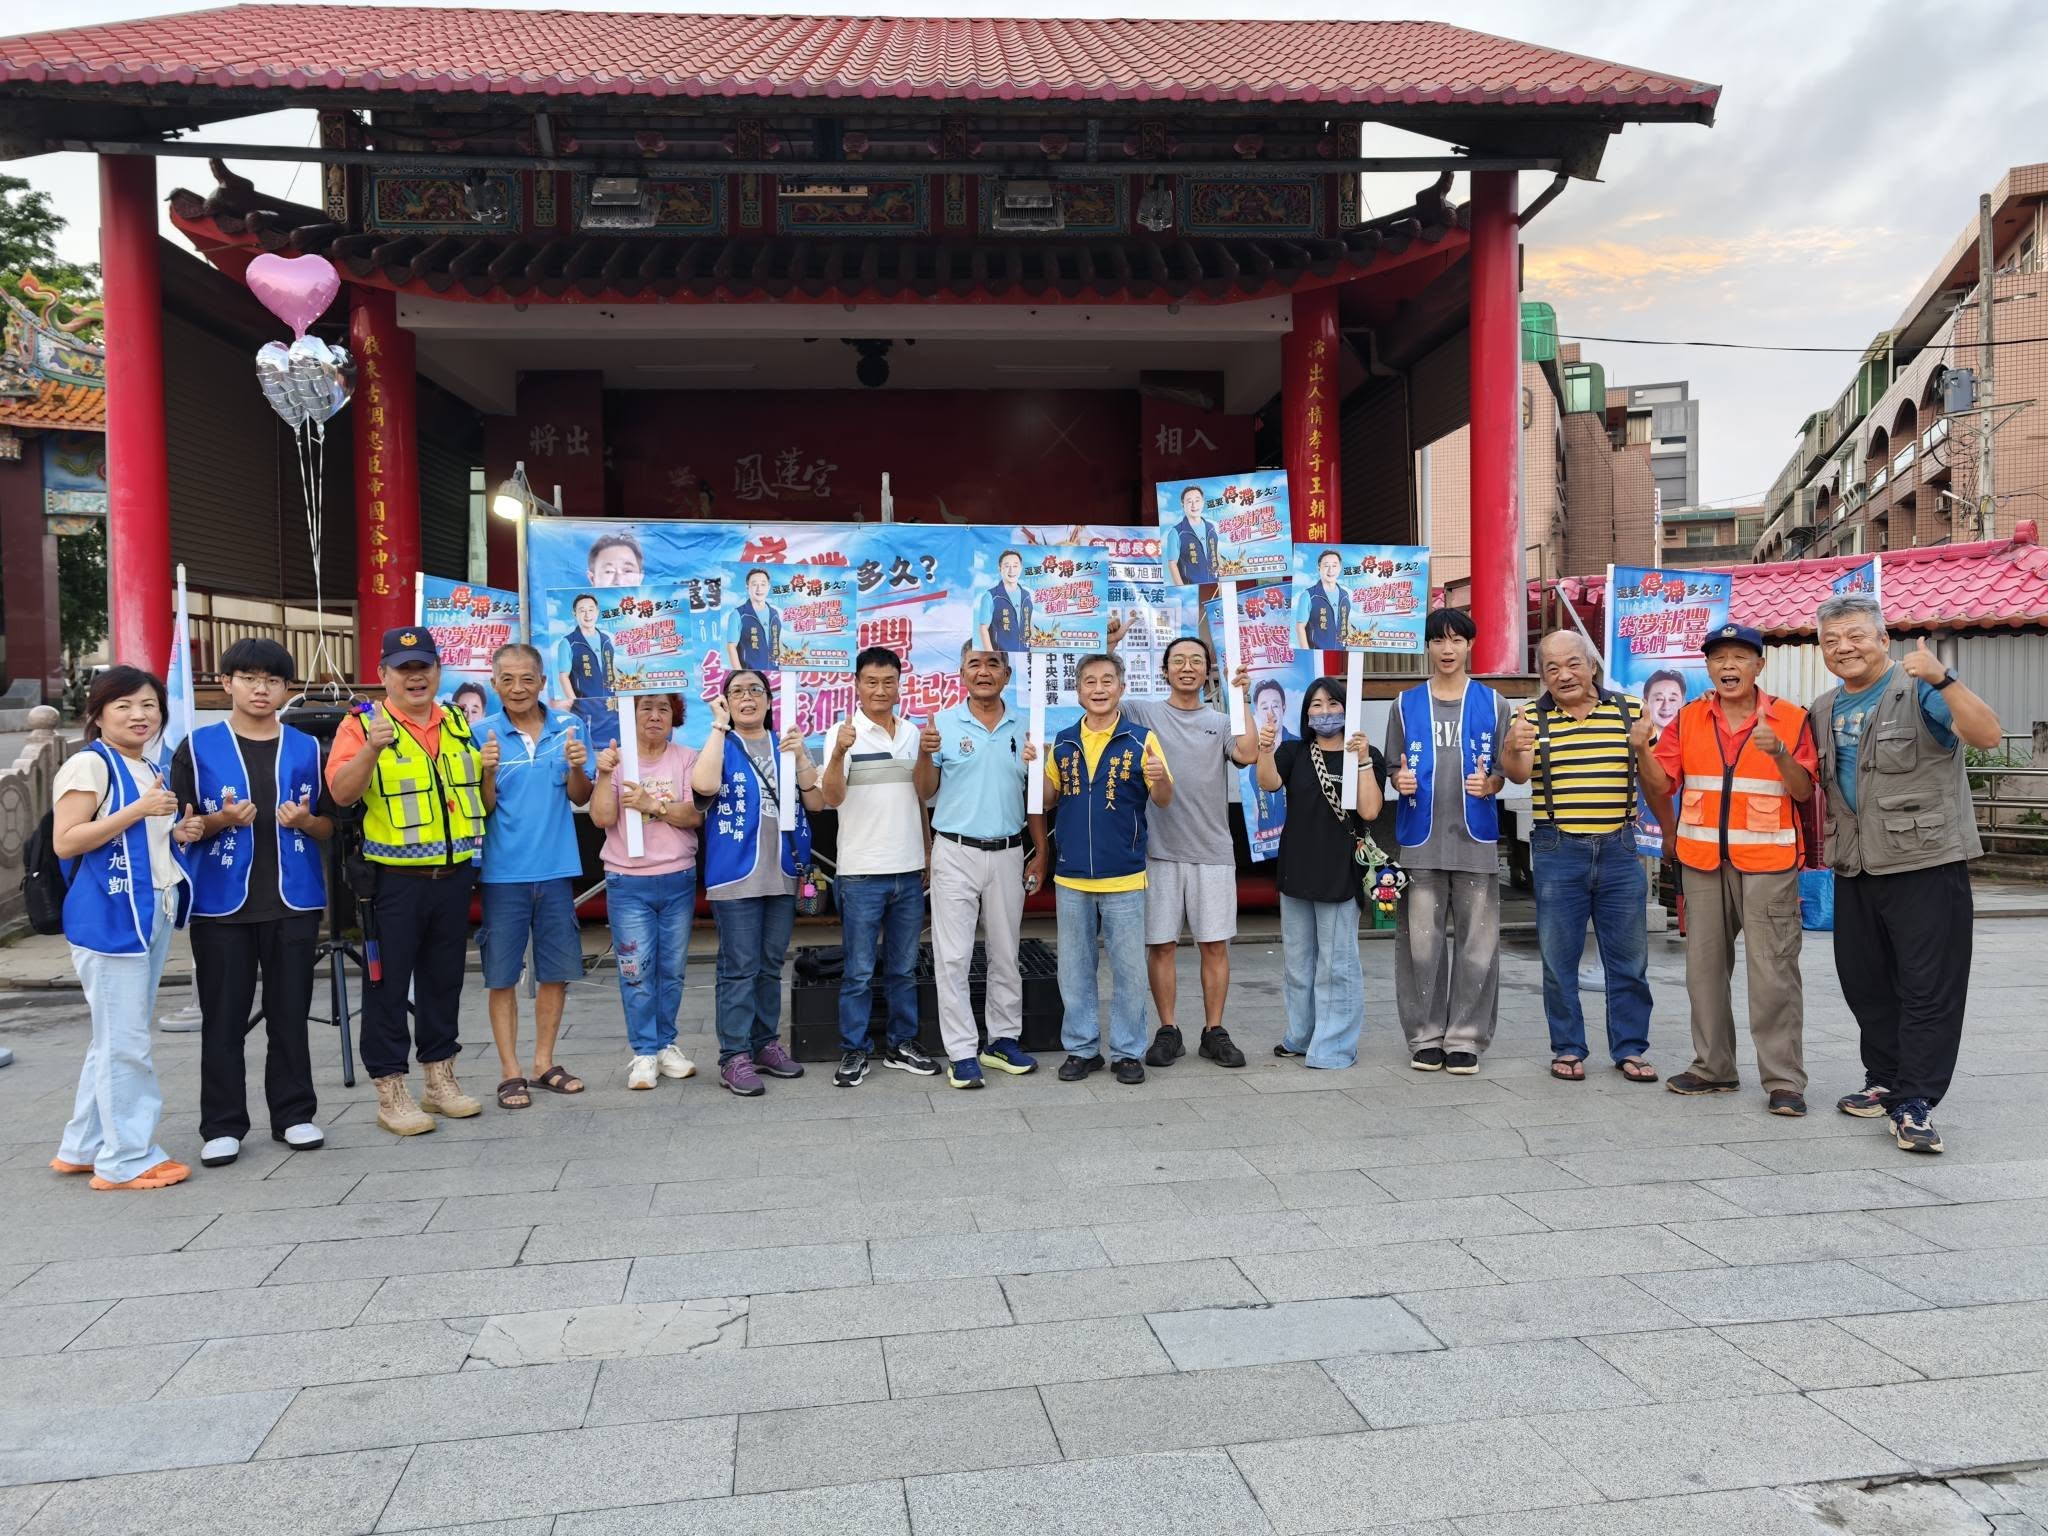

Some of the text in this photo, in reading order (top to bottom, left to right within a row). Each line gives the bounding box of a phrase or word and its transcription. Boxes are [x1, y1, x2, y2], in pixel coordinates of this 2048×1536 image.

[1618, 607, 1710, 639] 築夢新豐
[1045, 652, 1059, 705] 中央經費
[733, 772, 747, 842] 經營魔法師
